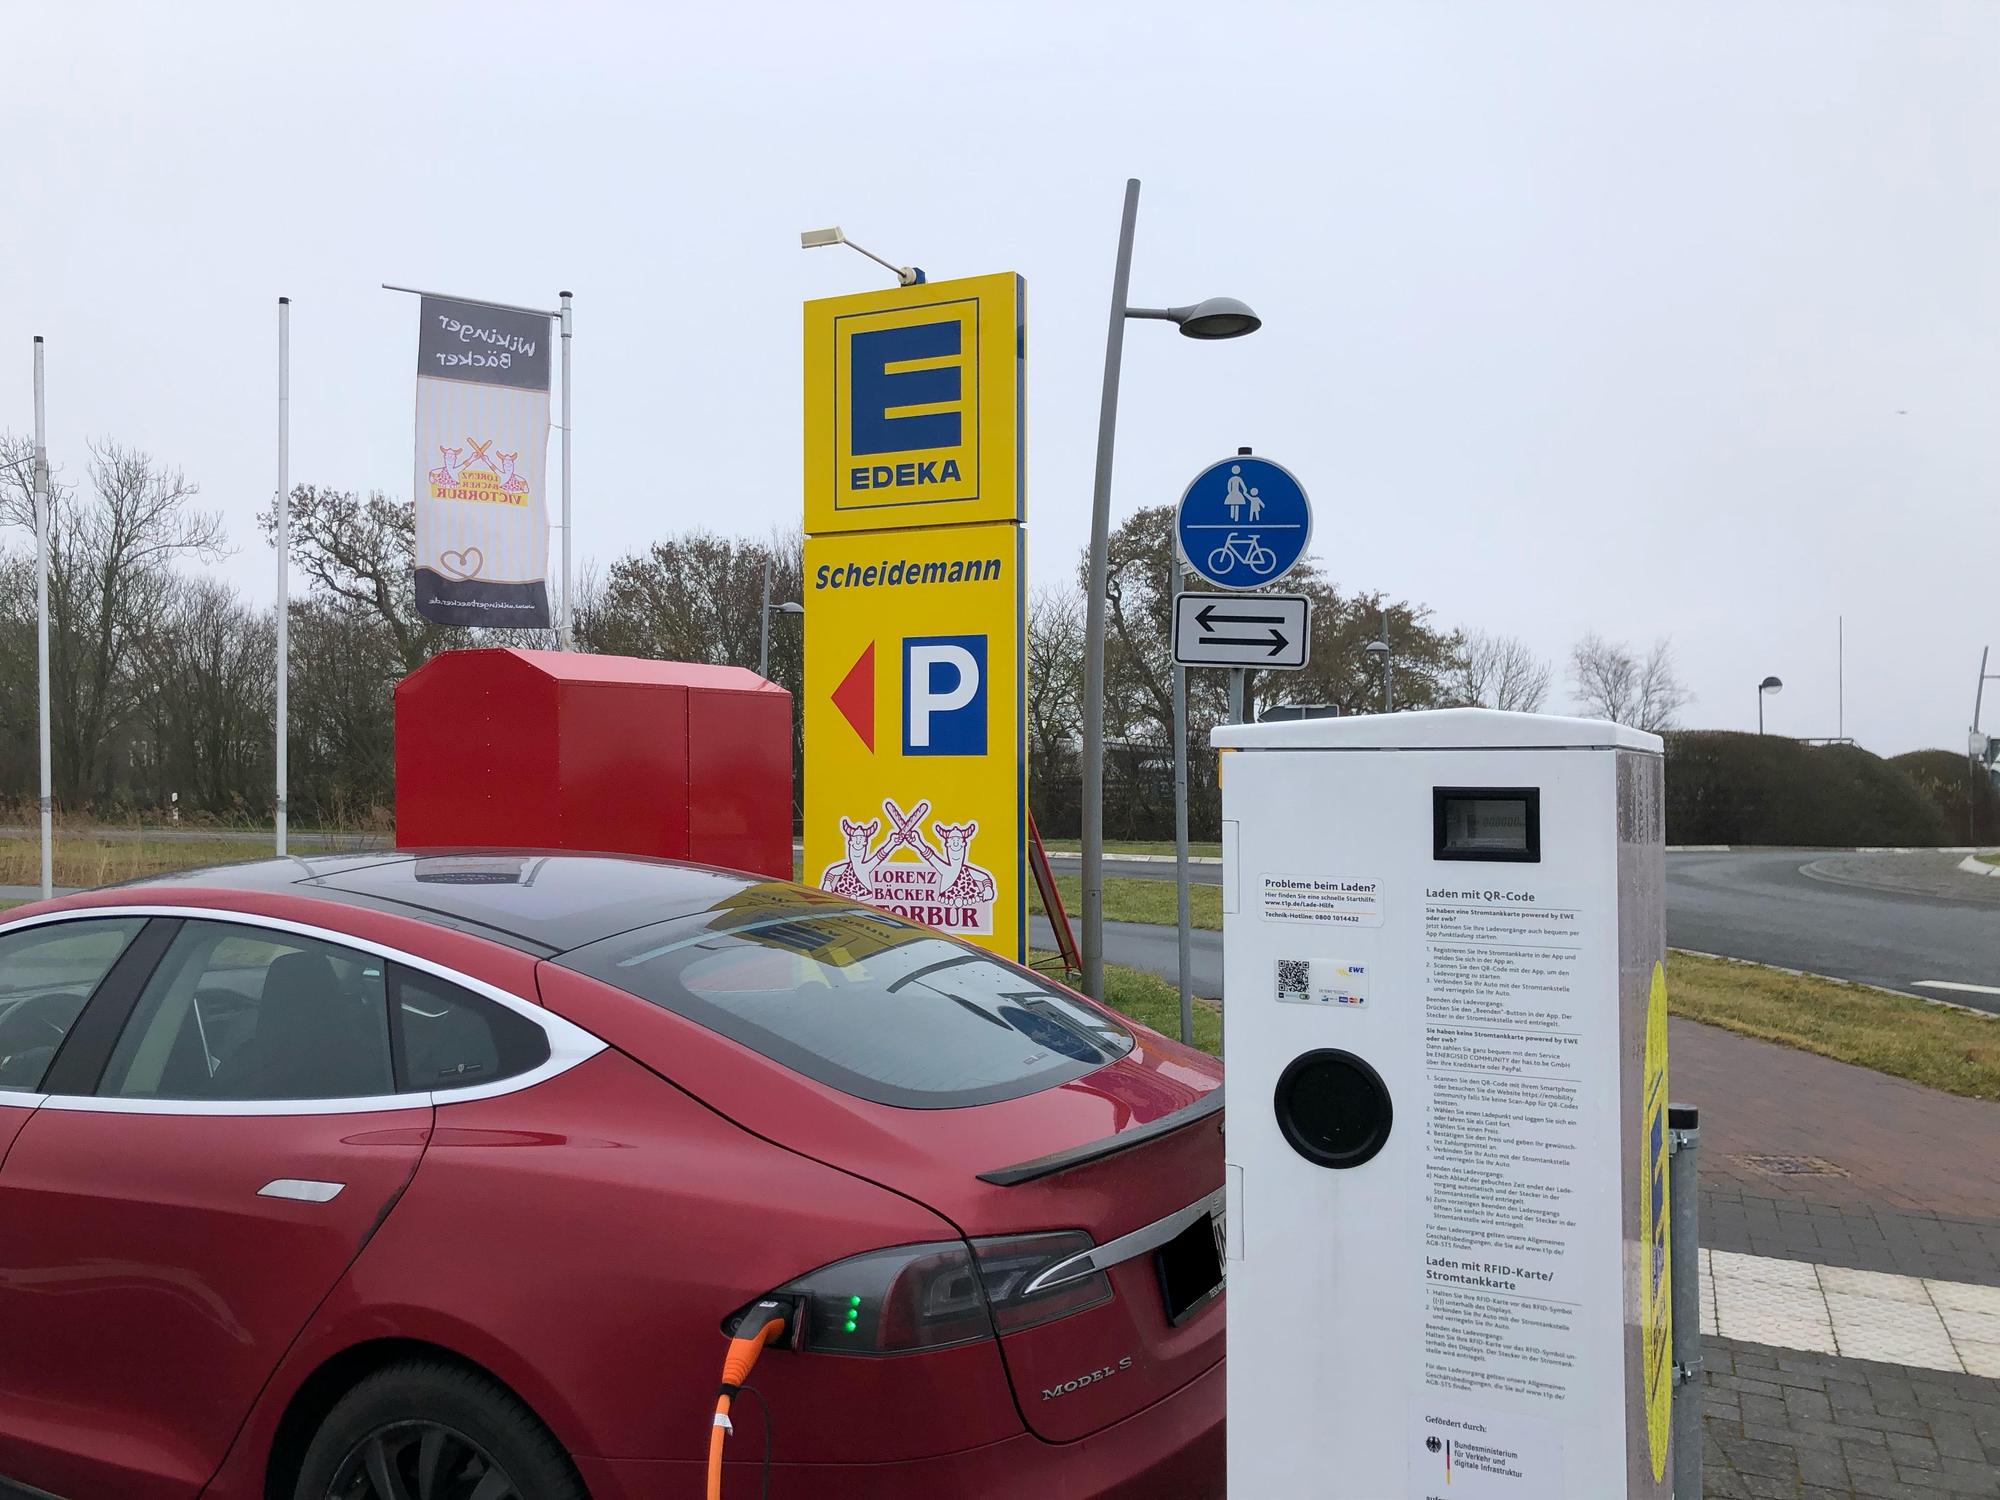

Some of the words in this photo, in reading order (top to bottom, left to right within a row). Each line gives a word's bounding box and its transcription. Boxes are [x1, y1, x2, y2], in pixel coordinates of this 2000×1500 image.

[851, 460, 961, 490] EDEKA
[816, 559, 1001, 589] Scheidemann
[910, 645, 979, 746] P
[874, 871, 937, 884] LORENZ
[1265, 879, 1311, 890] Probleme
[1314, 881, 1338, 891] beim
[1341, 882, 1375, 893] Laden?
[874, 884, 935, 901] BÄCKER
[1426, 889, 1458, 899] Laden
[1461, 890, 1480, 900] mit
[1483, 891, 1535, 902] QR-Code
[1265, 900, 1334, 909] www.t1p.de/Lade-Hilfe
[1486, 926, 1527, 934] Ladevorgänge
[1474, 1031, 1524, 1040] Stromtankkarte
[1525, 1035, 1553, 1044] powered
[1426, 1256, 1458, 1269] Laden
[1461, 1260, 1480, 1272] mit
[1484, 1263, 1553, 1281] RFID-Karte/
[1426, 1270, 1516, 1291] Stromtankkarte
[1042, 1367, 1115, 1400] MODEL
[1119, 1357, 1132, 1369] S
[1425, 1416, 1461, 1428] Gefördert
[1462, 1422, 1487, 1433] durch:
[1454, 1441, 1518, 1460] Bundesministerium
[1454, 1451, 1464, 1459] für
[1465, 1453, 1491, 1464] Verkehr
[1492, 1457, 1506, 1466] und
[1454, 1460, 1479, 1472] digitale
[1480, 1464, 1522, 1478] Infrastruktur
